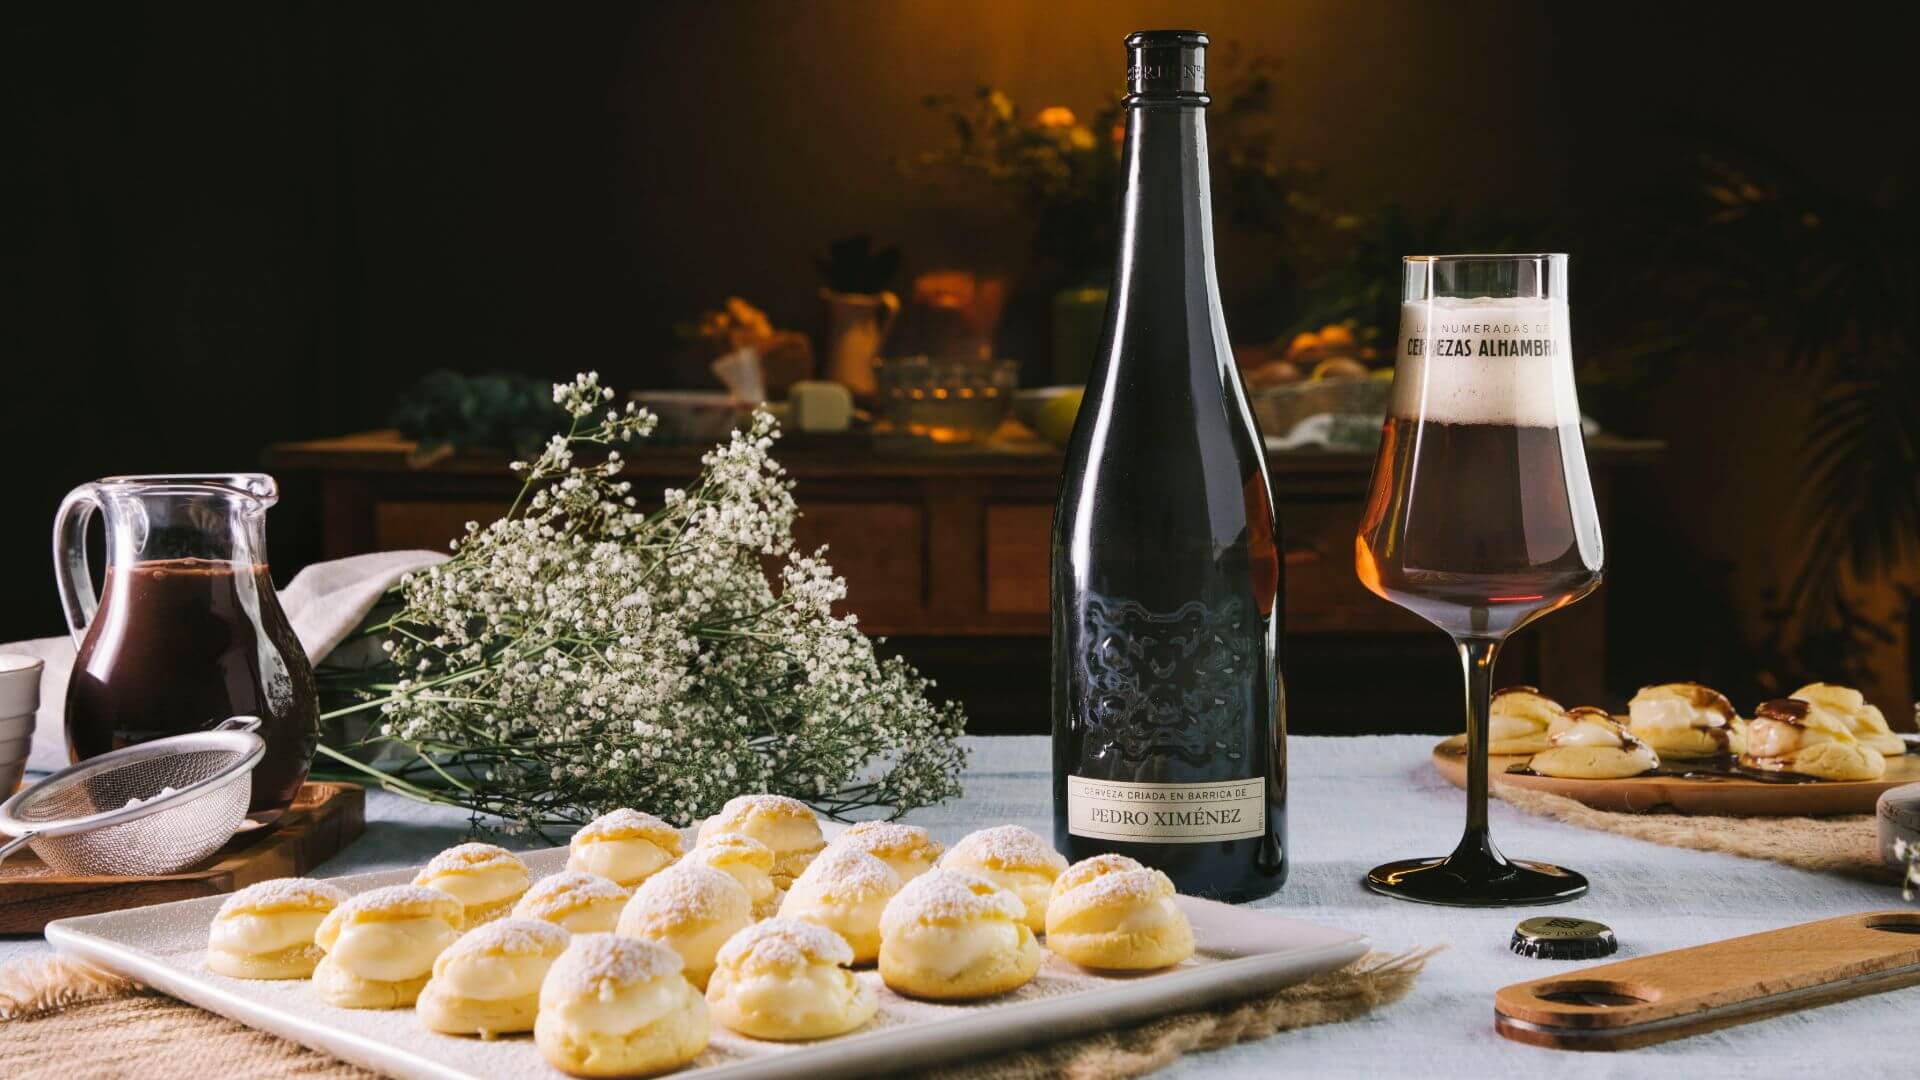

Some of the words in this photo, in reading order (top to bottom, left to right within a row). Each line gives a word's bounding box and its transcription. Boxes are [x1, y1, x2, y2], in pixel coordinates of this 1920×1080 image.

[1441, 324, 1529, 334] NUMERADAS
[1084, 786, 1123, 799] CERVEZA
[1127, 790, 1165, 801] CRIADA
[1170, 791, 1183, 801] EN
[1188, 789, 1231, 801] BARRICA
[1235, 788, 1247, 798] DE
[1091, 807, 1149, 826] PEDRO
[1153, 806, 1241, 826] XIMÉNEZ
